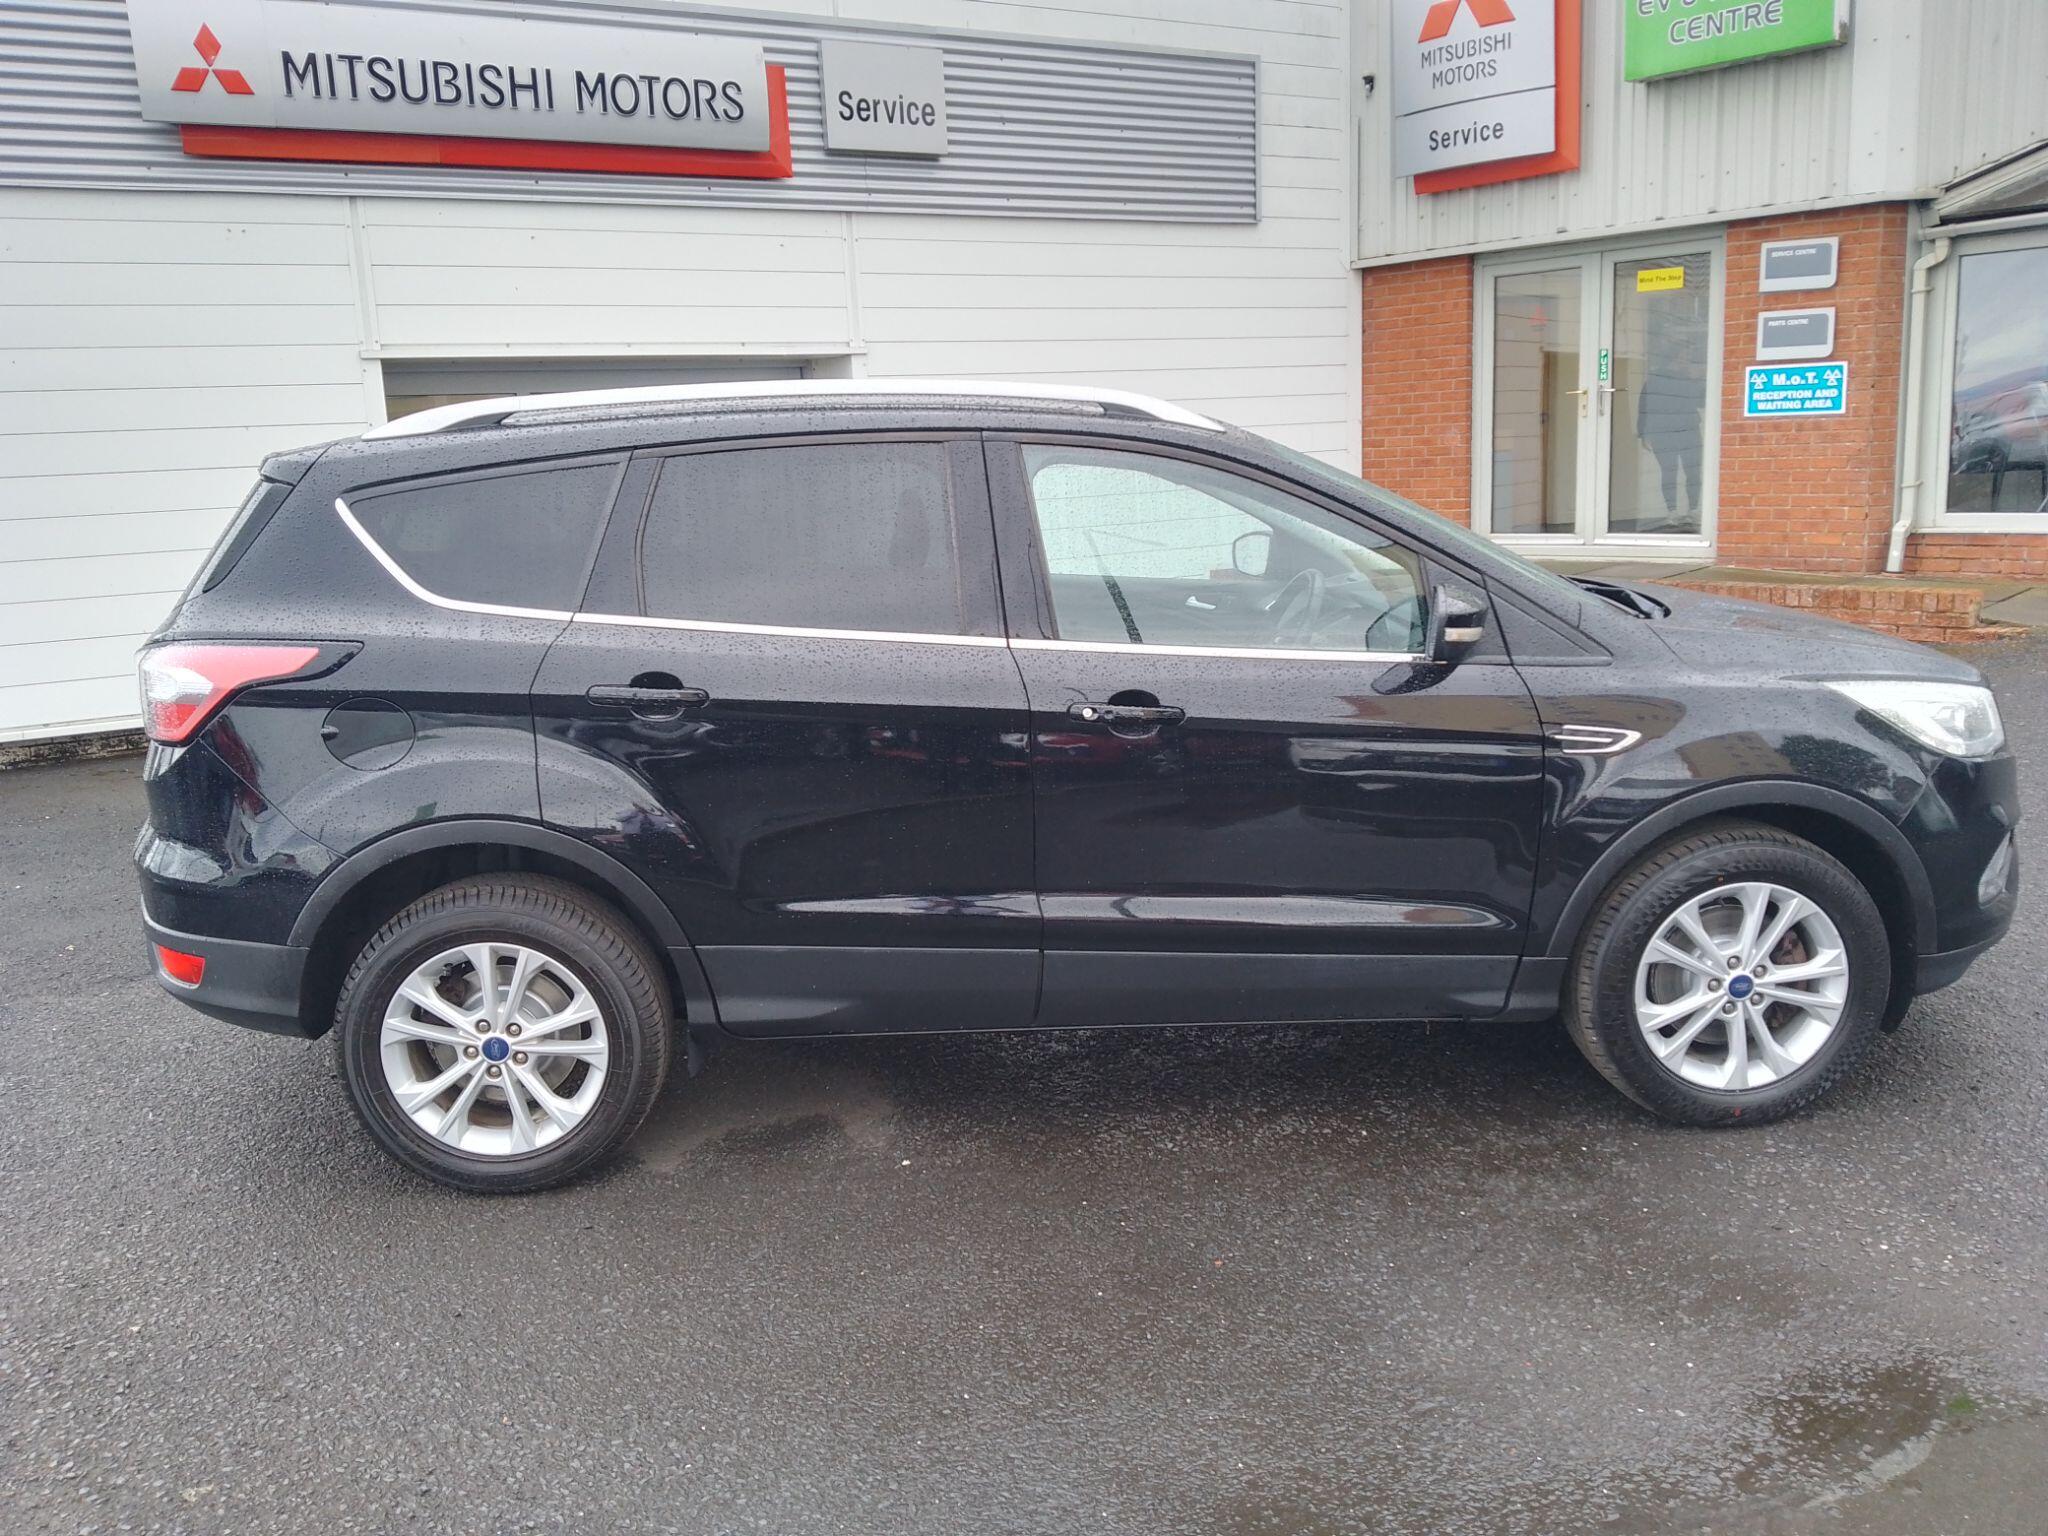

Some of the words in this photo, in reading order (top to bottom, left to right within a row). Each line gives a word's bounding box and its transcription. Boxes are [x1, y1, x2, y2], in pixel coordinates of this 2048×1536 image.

[1670, 0, 1782, 44] CENTRE
[1421, 32, 1512, 69] MITSUBISHI
[281, 50, 554, 111] MITSUBISHI
[574, 70, 744, 122] MOTORS
[1432, 59, 1498, 90] MOTORS
[838, 90, 936, 127] Service
[1428, 121, 1504, 151] Service
[1600, 349, 1609, 380] PUSH
[1752, 389, 1813, 401] RECEPTION
[1814, 388, 1839, 398] AND
[1757, 400, 1802, 411] WAITING
[1803, 398, 1834, 409] AREA
